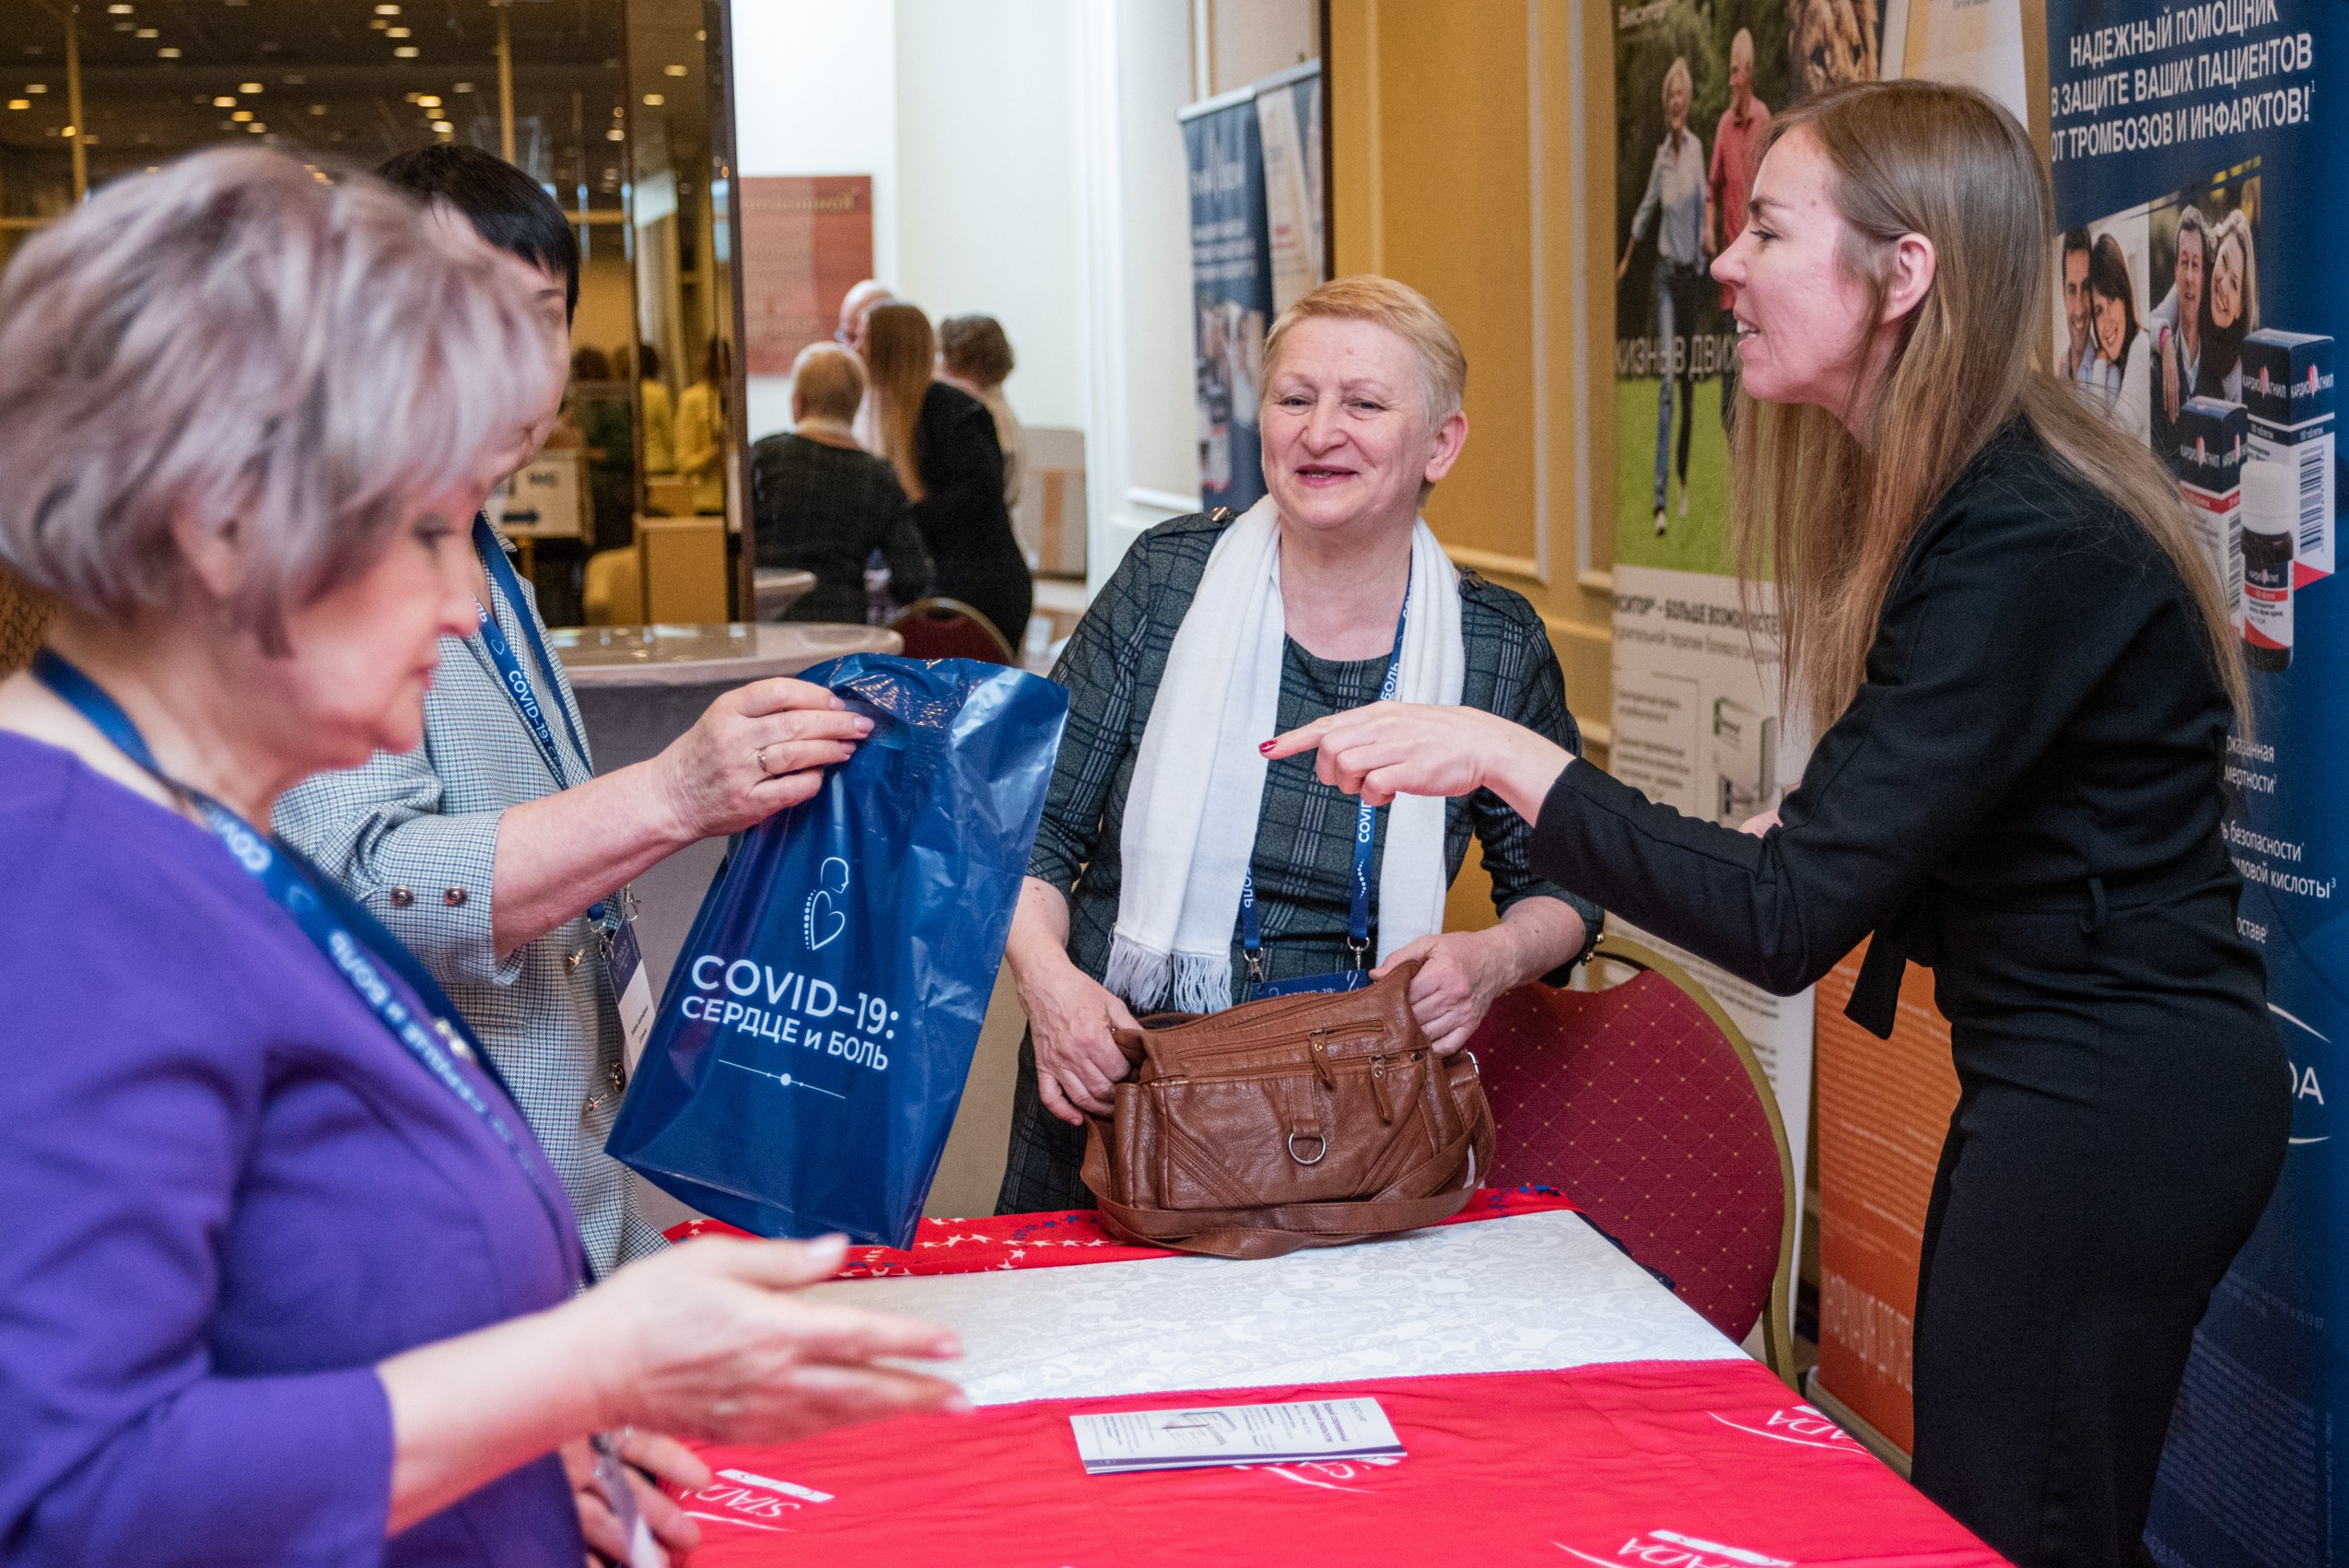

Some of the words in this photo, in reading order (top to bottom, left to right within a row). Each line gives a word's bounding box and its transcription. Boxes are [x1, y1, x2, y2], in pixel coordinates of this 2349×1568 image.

[2071, 7, 2172, 68] НАДЕЖНЫЙ
[2177, 0, 2278, 42] ПОМОЩНИК
[2051, 87, 2059, 117] В
[2061, 72, 2129, 115] ЗАЩИТЕ
[2134, 58, 2194, 102] ВАШИХ
[2199, 32, 2313, 89] ПАЦИЕНТОВ
[2051, 130, 2066, 162] ОТ
[2069, 111, 2173, 158] ТРОМБОЗОВ
[2177, 108, 2187, 143] И
[1381, 661, 1400, 702] БОЛЬ
[692, 954, 899, 1039] COVID-19:
[682, 996, 801, 1044] СЕРДЦЕ
[827, 1031, 889, 1071] БОЛЬ
